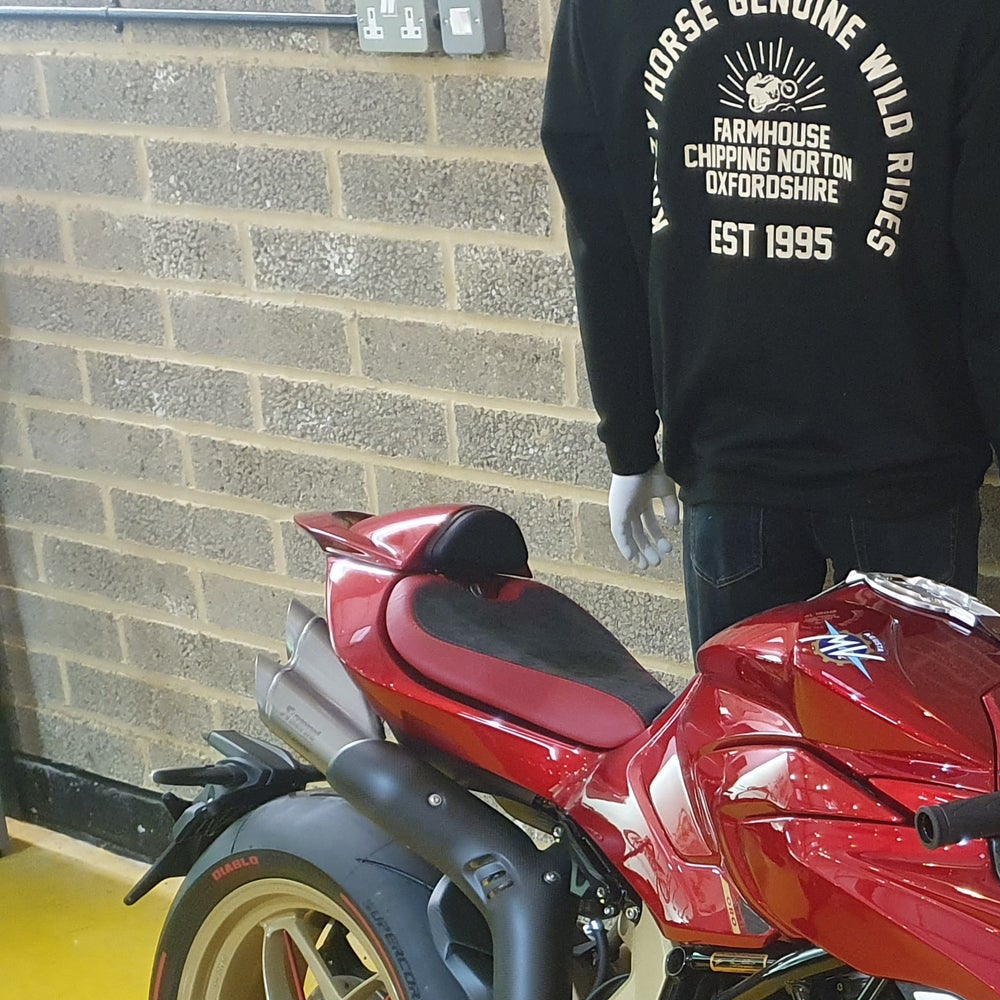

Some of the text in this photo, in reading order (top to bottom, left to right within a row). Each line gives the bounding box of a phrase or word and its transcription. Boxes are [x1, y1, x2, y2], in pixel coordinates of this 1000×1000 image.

[643, 0, 719, 102] HORSE
[859, 42, 914, 138] WILD
[713, 117, 831, 150] FARMHOUSE
[646, 108, 669, 234] KZY
[683, 143, 852, 182] CHIPPING NORTON
[706, 170, 839, 204] OXFORDSHIRE
[866, 152, 914, 258] RIDES
[710, 219, 833, 261] EST 1995
[211, 855, 260, 881] DIABLO
